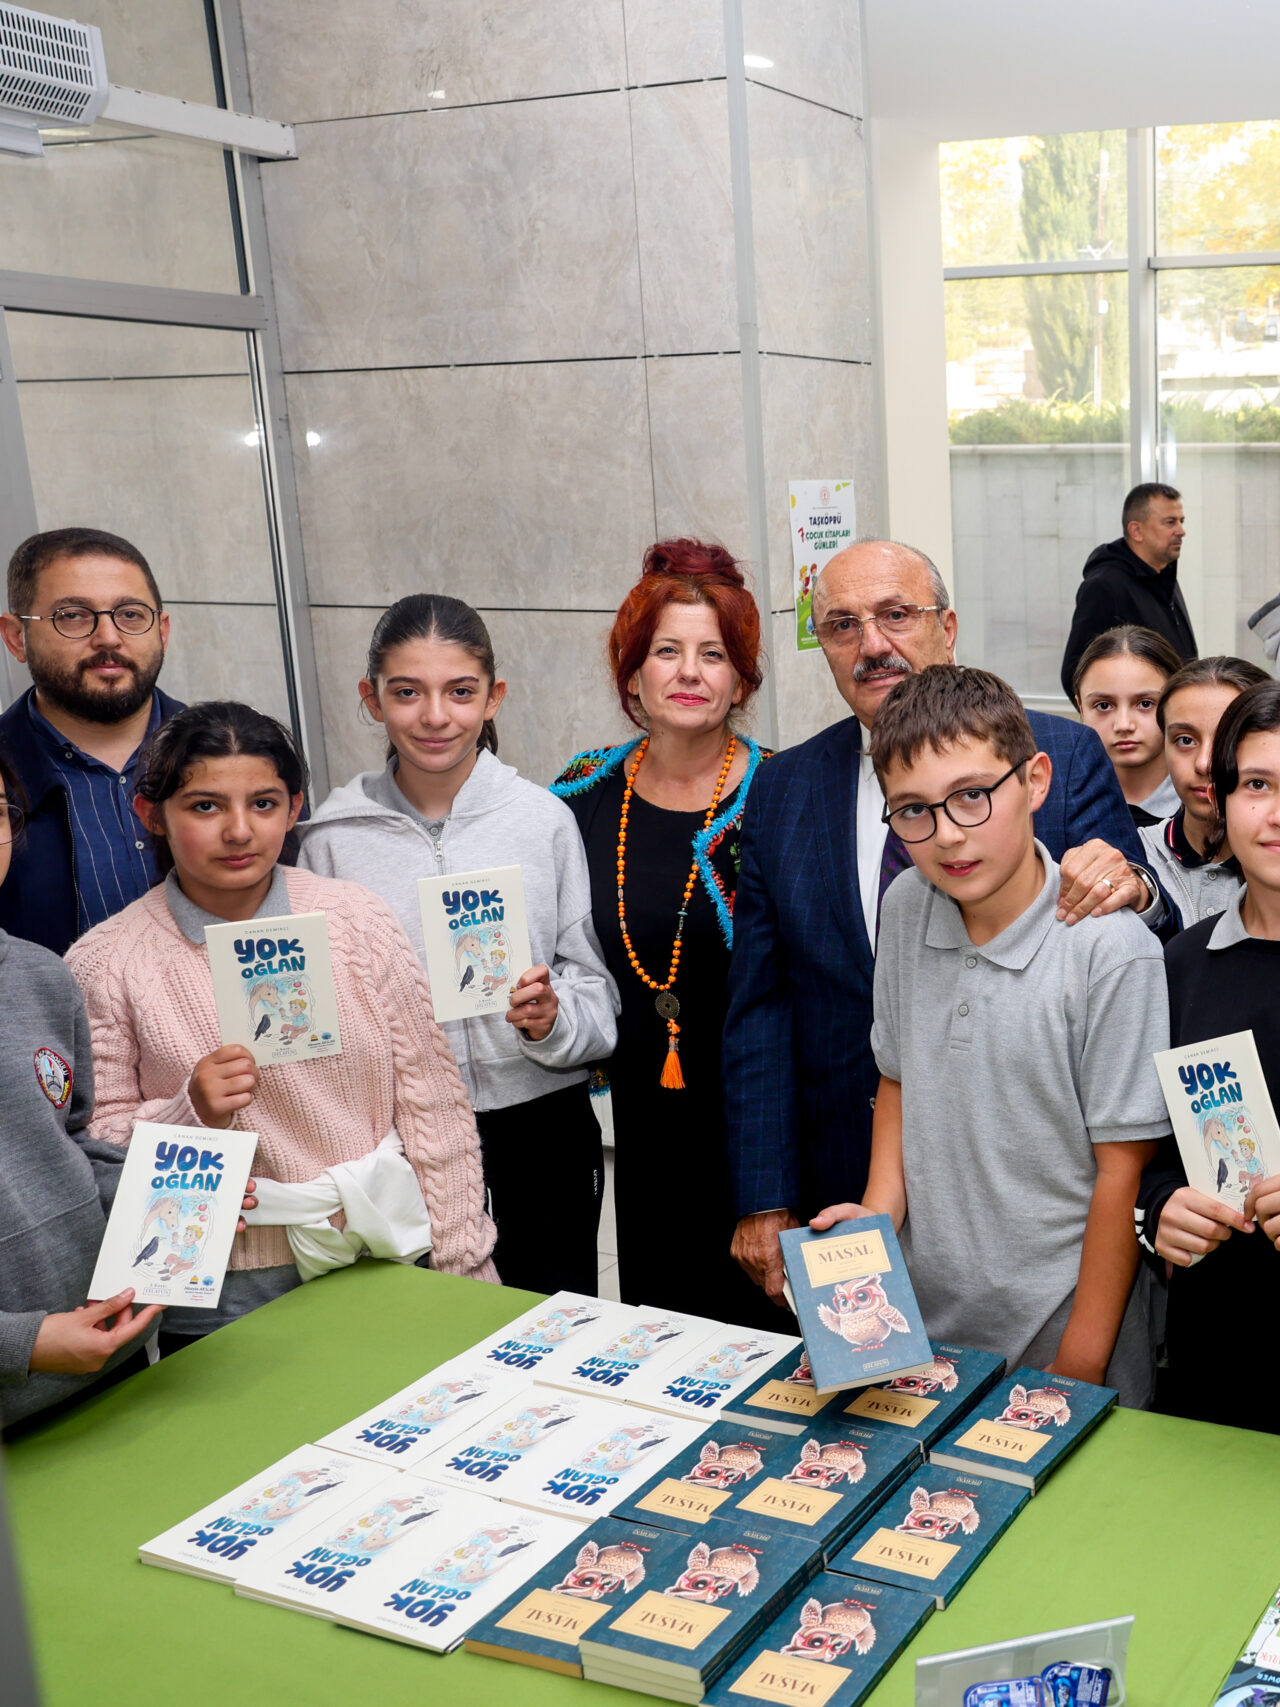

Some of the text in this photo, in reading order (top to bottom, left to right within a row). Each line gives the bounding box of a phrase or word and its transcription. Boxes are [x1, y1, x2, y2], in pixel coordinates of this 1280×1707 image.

[809, 512, 842, 526] TAŞKÖPRÜ
[806, 530, 824, 540] ÇOCUK
[814, 538, 838, 550] GÜNLERİ
[442, 890, 503, 915] YOK
[449, 906, 504, 930] OĞLAN
[234, 938, 304, 964] YOK
[241, 956, 305, 978] OĞLAN
[1178, 1061, 1237, 1096] YOK
[1190, 1082, 1243, 1114] OĞLAN
[154, 1141, 225, 1171] YOK
[151, 1170, 222, 1192] OĞLAN
[818, 1244, 874, 1264] MASAL
[497, 1339, 554, 1354] OĞLAN
[486, 1350, 543, 1370] YOK
[582, 1356, 640, 1371] OĞLAN
[572, 1366, 630, 1387] YOK
[672, 1375, 731, 1391] OĞLAN
[662, 1385, 722, 1408] YOK
[767, 1392, 812, 1407] MASAL
[867, 1400, 916, 1417] MASAL
[370, 1419, 431, 1436] OĞLAN
[355, 1429, 418, 1454] YOK
[978, 1434, 1027, 1452] MASAL
[458, 1445, 521, 1462] OĞLAN
[445, 1456, 509, 1482] YOK
[554, 1468, 619, 1486] OĞLAN
[542, 1479, 608, 1506] YOK
[662, 1493, 712, 1513] MASAL
[763, 1494, 815, 1513] MASAL
[205, 1516, 274, 1537] OĞLAN
[187, 1529, 257, 1561] YOK
[301, 1546, 372, 1568] OĞLAN
[878, 1546, 935, 1567] MASAL
[284, 1560, 356, 1592] YOK
[400, 1578, 472, 1601] OĞLAN
[383, 1592, 456, 1627] YOK
[526, 1608, 583, 1630] MASAL
[639, 1611, 699, 1634] MASAL
[760, 1672, 822, 1695] MASAL
